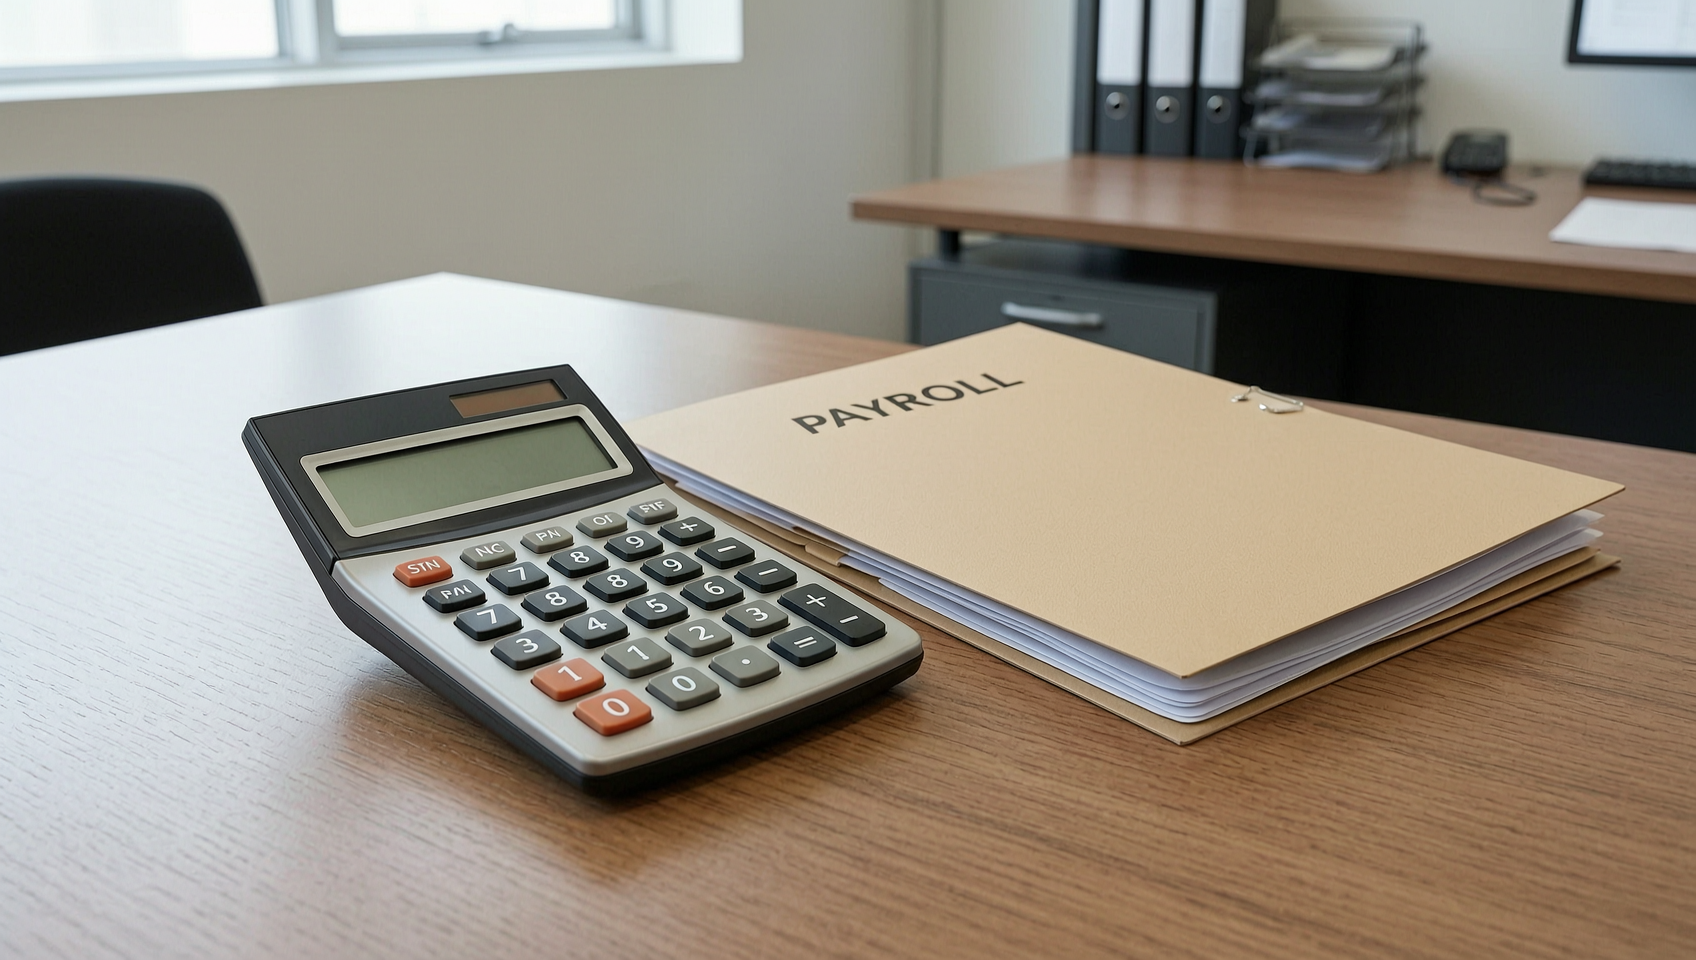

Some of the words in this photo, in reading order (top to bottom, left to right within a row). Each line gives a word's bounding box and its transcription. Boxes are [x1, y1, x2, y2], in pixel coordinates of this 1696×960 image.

[791, 372, 1024, 435] PAYROLL
[625, 535, 645, 549] 9
[570, 551, 590, 563] 8
[407, 558, 440, 574] STN
[662, 558, 683, 572] 9
[507, 566, 526, 581] 7
[606, 574, 628, 588] 8
[703, 581, 725, 595] 6
[545, 591, 567, 606] 8
[645, 598, 668, 613] 5
[476, 608, 497, 625] 7
[745, 607, 769, 622] 3
[587, 616, 608, 630] 4
[688, 625, 714, 641] 2
[515, 638, 539, 653] 3
[627, 645, 650, 660] 1
[557, 665, 582, 682] 1
[671, 675, 697, 692] 0
[602, 697, 630, 716] 0
